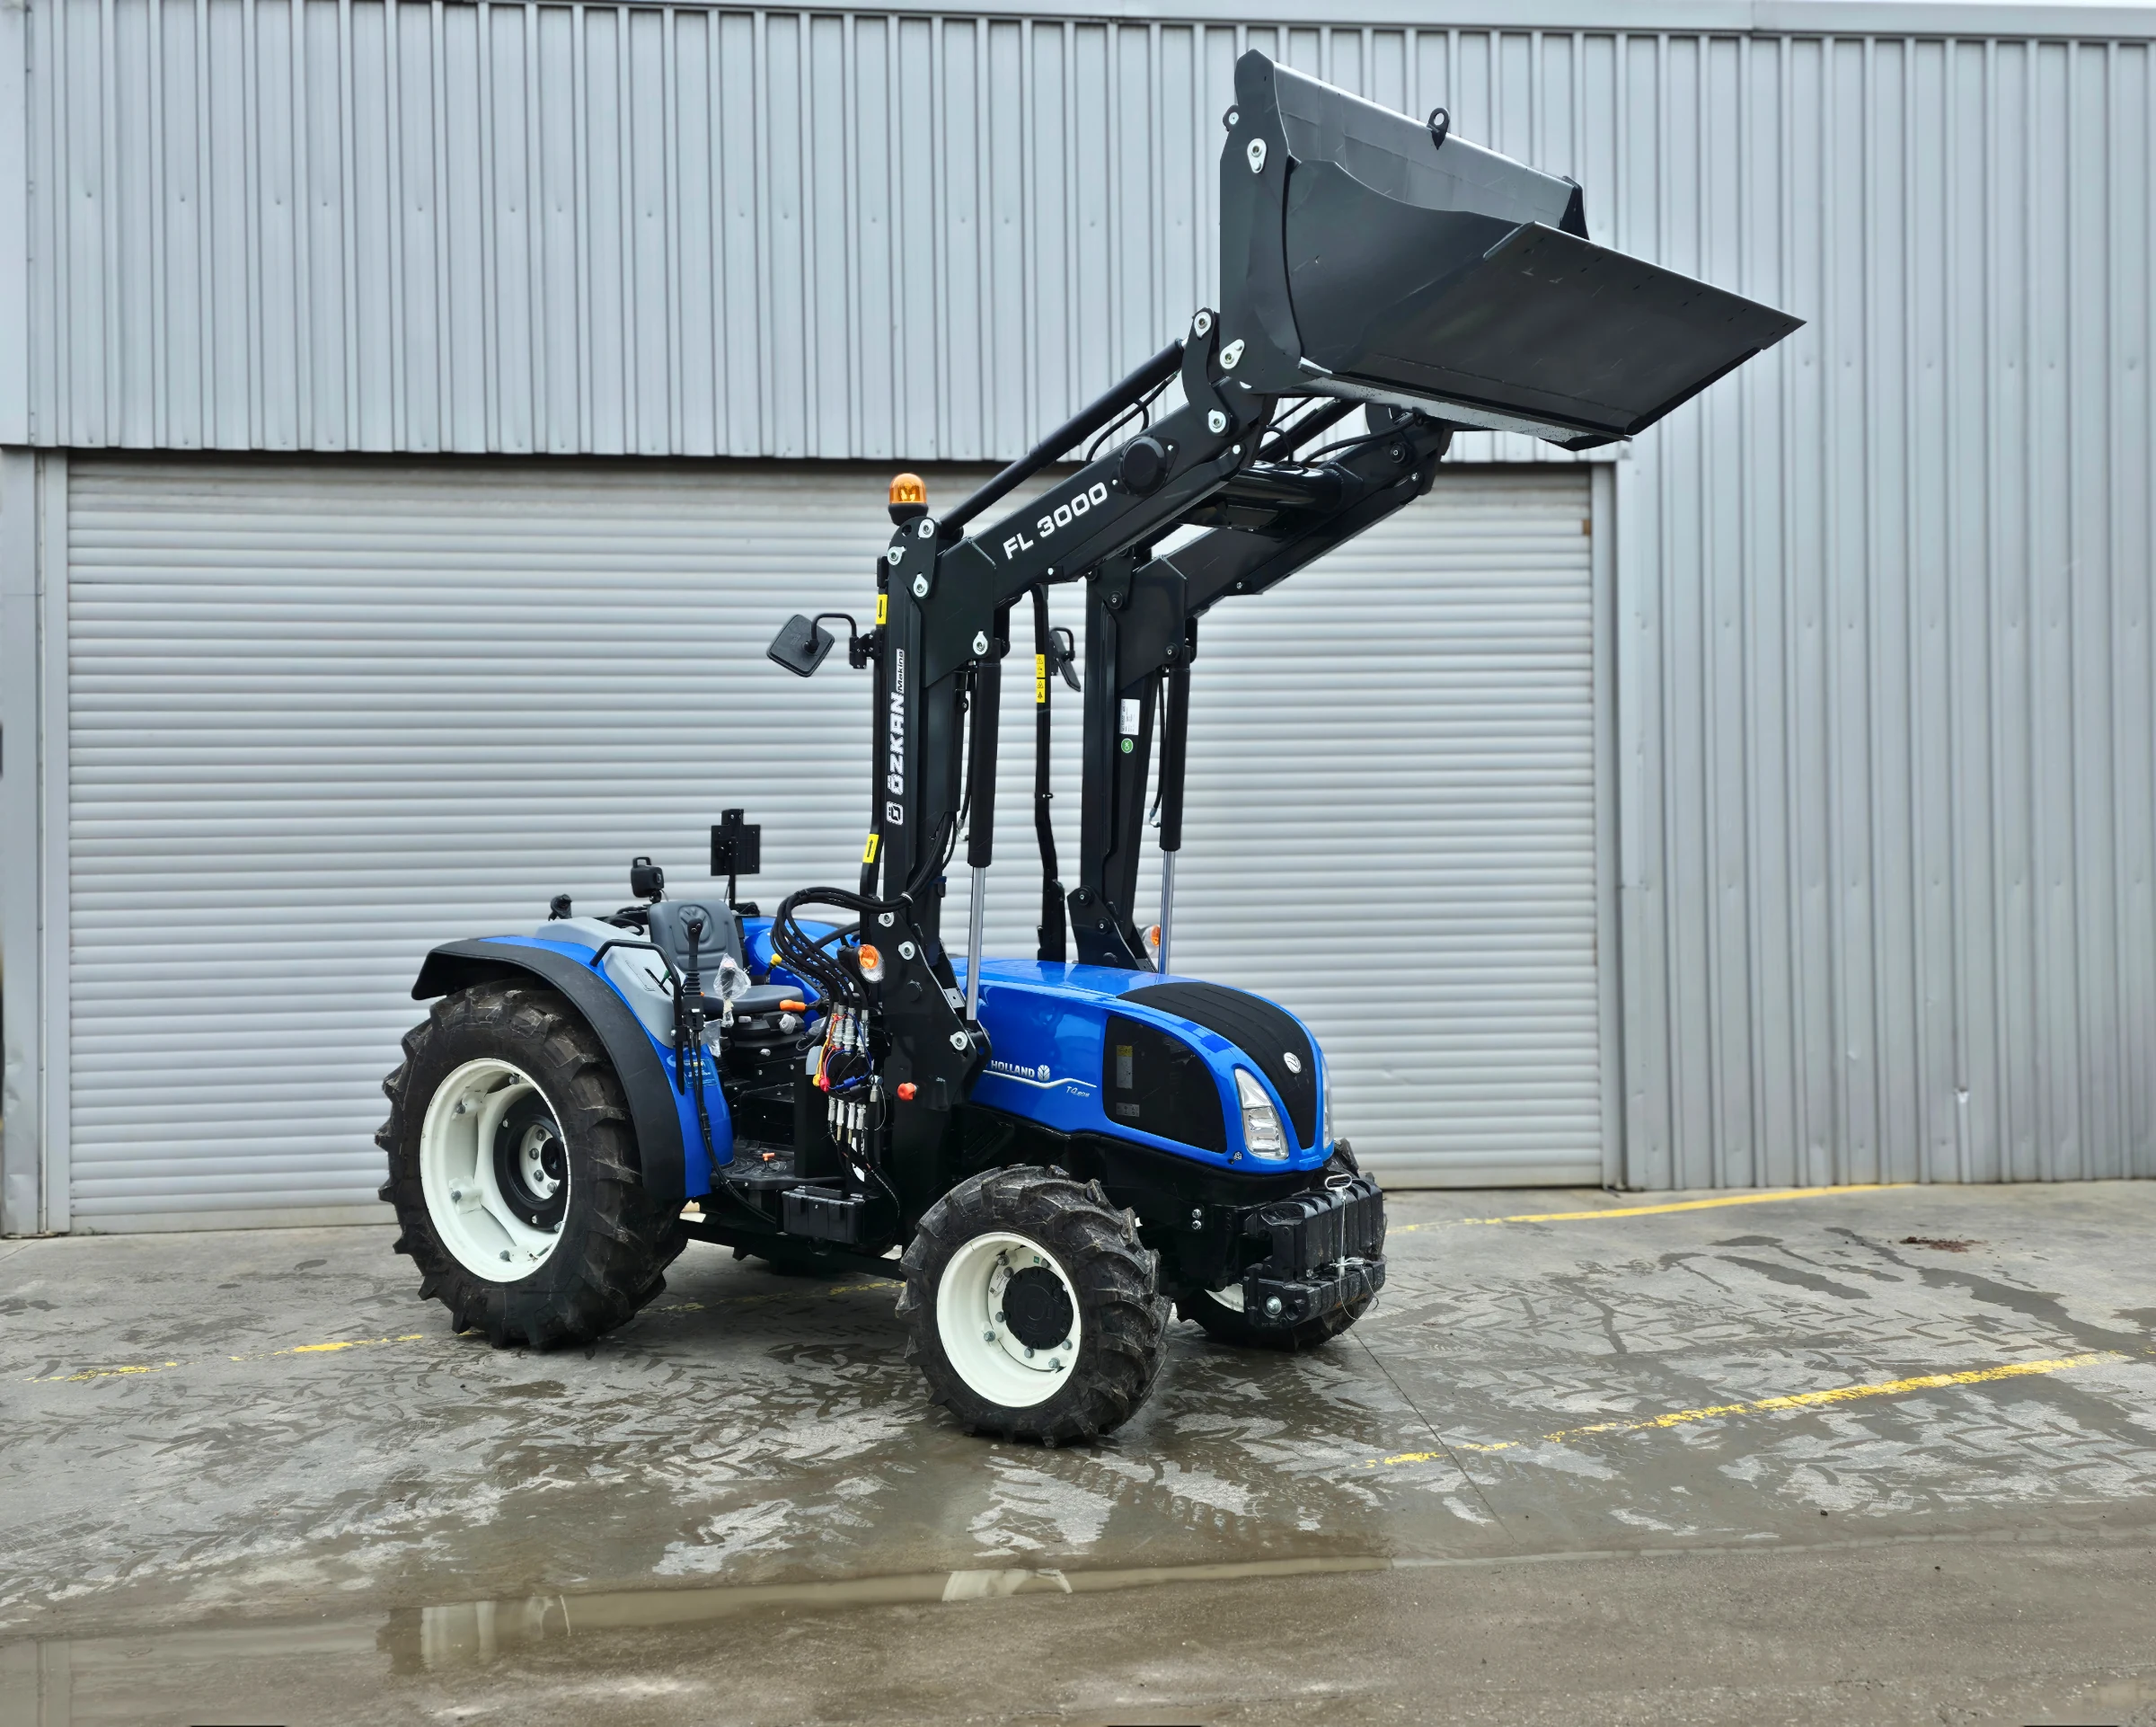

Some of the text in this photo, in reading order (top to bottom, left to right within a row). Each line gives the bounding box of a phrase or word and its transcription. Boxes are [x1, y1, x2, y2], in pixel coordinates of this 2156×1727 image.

[1003, 482, 1108, 560] FL 3000
[887, 692, 904, 795] ÖZKAN
[897, 649, 905, 693] Makina
[991, 1059, 1036, 1078] HOLLAND
